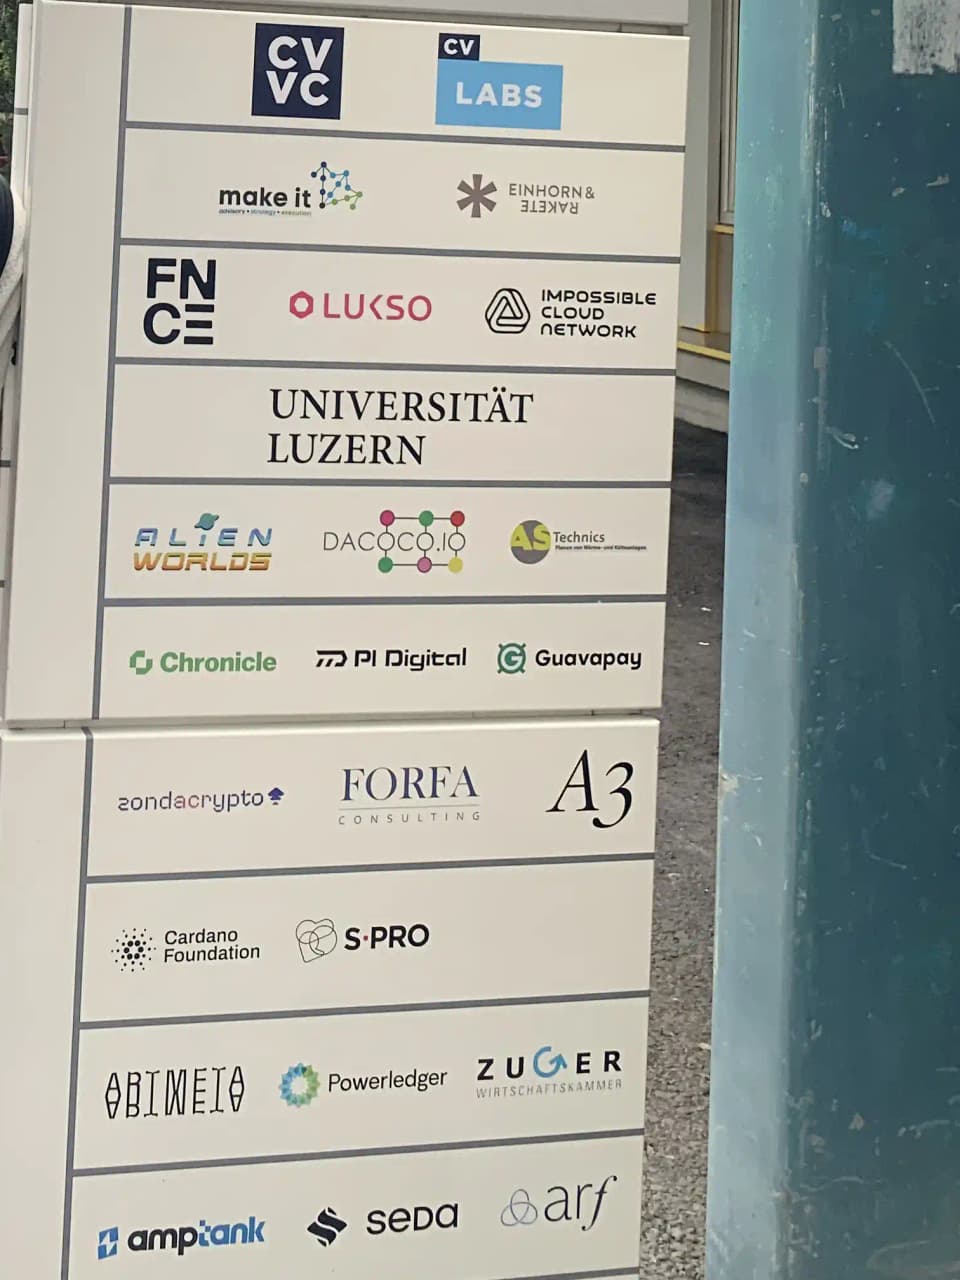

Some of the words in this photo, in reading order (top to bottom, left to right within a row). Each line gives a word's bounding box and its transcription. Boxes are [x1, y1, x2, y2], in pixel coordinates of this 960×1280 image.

[267, 36, 333, 71] CV
[443, 38, 475, 56] CV
[266, 70, 330, 107] VC
[456, 81, 542, 108] LABS
[219, 187, 288, 207] make
[295, 187, 311, 208] it
[520, 200, 579, 214] RAKETE
[147, 258, 216, 300] FN
[324, 292, 432, 321] LUKSO
[541, 289, 657, 306] IMPOSSIBLE
[541, 306, 605, 322] CLOUD
[540, 322, 637, 338] NETWORK
[270, 387, 534, 424] UNIVERSITÄT
[267, 433, 426, 466] LUZERN
[134, 523, 273, 548] ALIEN
[323, 531, 466, 552] DACOCO.IO
[510, 523, 551, 551] AS
[553, 531, 605, 543] Technics
[133, 551, 272, 572] WORLDS
[160, 651, 277, 674] Chronicle
[354, 649, 376, 667] PI
[385, 648, 467, 671] Digital
[535, 649, 642, 673] Guavapay
[341, 765, 479, 801] FORFA
[546, 749, 634, 829] A3
[118, 787, 264, 812] zondacrypto
[338, 810, 481, 826] CONSULTING
[164, 928, 238, 946] Cardano
[163, 944, 260, 964] Foundation
[477, 1046, 622, 1081] ZUGER
[328, 1067, 448, 1094] Powerledger
[476, 1079, 623, 1099] WIRTSCHAFTSKAMMER
[544, 1175, 618, 1231] arf
[127, 1216, 266, 1257] amptank
